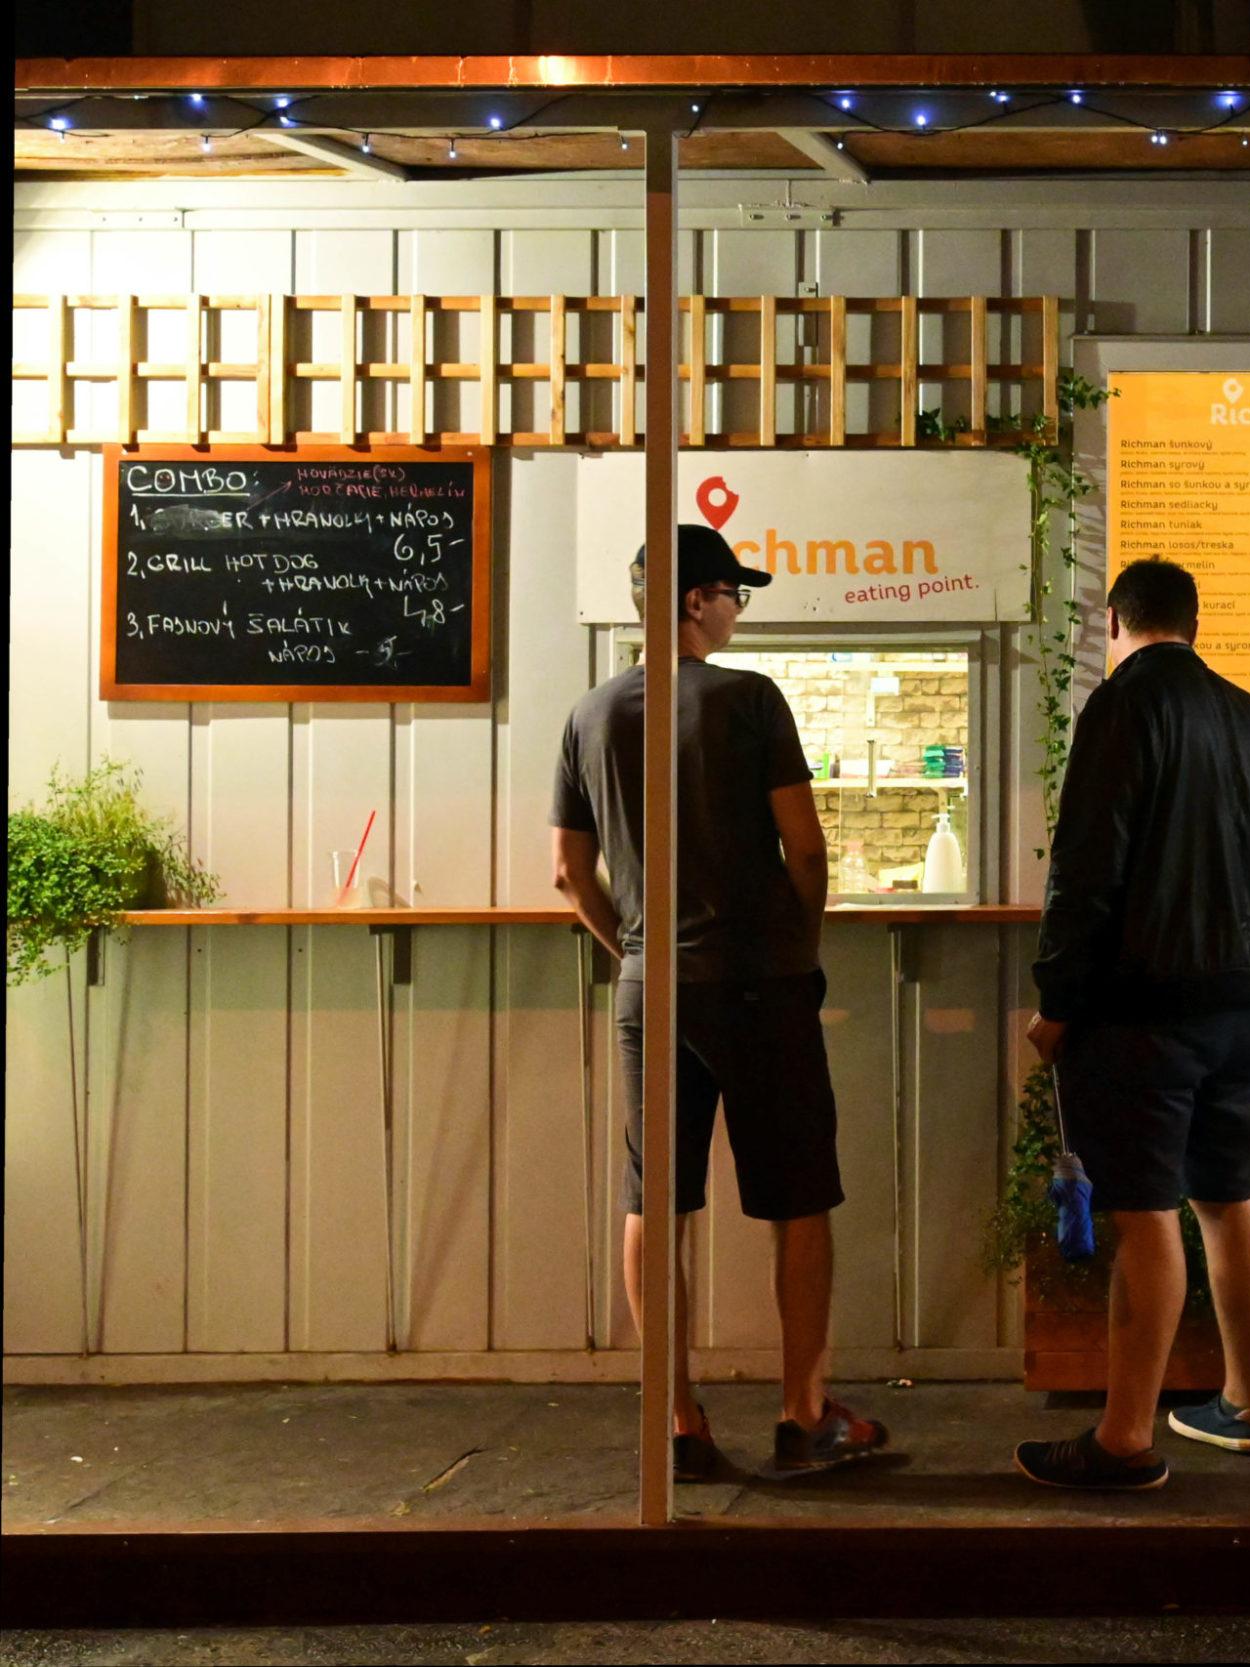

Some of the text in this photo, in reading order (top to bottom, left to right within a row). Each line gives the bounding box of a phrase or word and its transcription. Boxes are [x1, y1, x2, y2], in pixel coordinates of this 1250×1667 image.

[1121, 440, 1166, 448] Richman
[1121, 460, 1166, 468] Richman
[1121, 480, 1166, 488] Richman
[1121, 500, 1166, 509] Richman
[1121, 520, 1202, 529] Richman tuniak
[1121, 540, 1166, 549] Richman
[733, 528, 938, 575] chman
[147, 554, 212, 574] GRILL
[844, 574, 980, 604] eating point.
